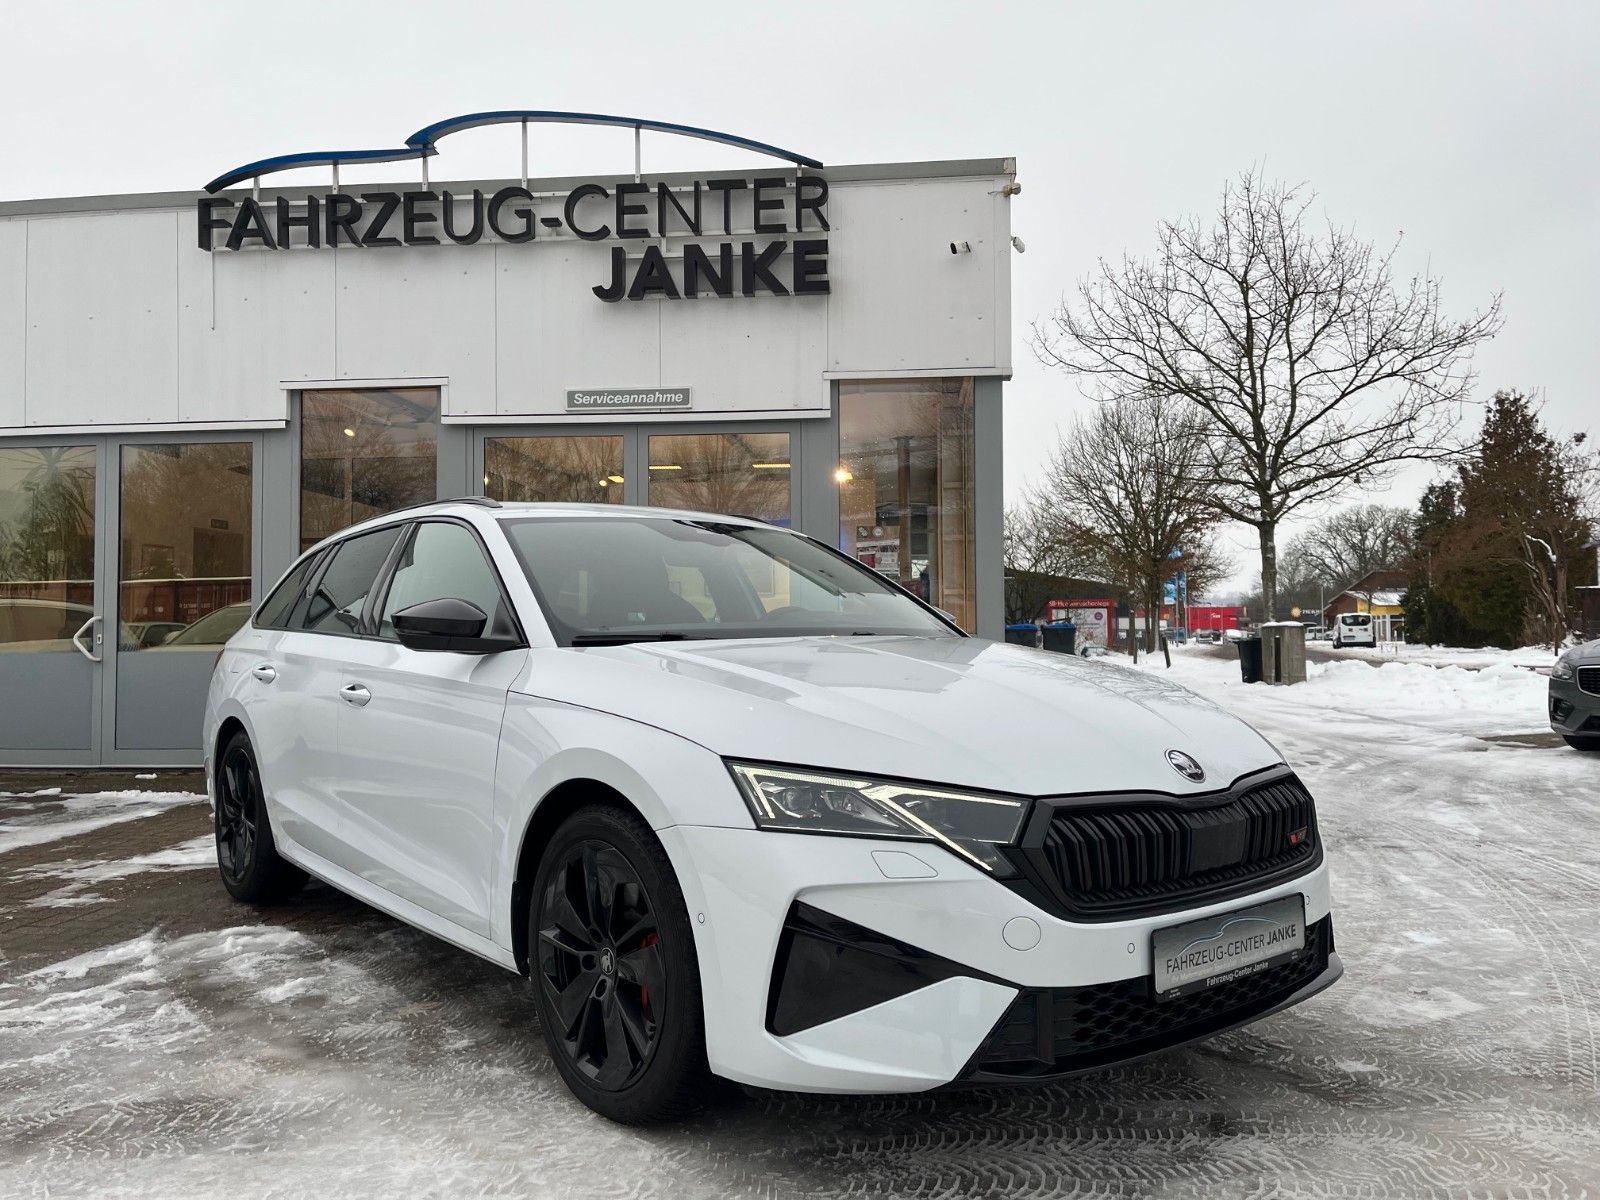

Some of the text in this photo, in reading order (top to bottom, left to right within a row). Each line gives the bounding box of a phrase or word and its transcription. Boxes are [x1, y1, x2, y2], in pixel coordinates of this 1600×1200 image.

[197, 176, 830, 251] FAHRZEUG-CENTER
[592, 239, 831, 303] JANKE
[573, 391, 683, 405] Serviceannahme
[1166, 933, 1265, 974] FAHRZEUG-CENTER
[1266, 923, 1297, 946] JANKE
[1206, 966, 1253, 987] Fahrzeug-Center
